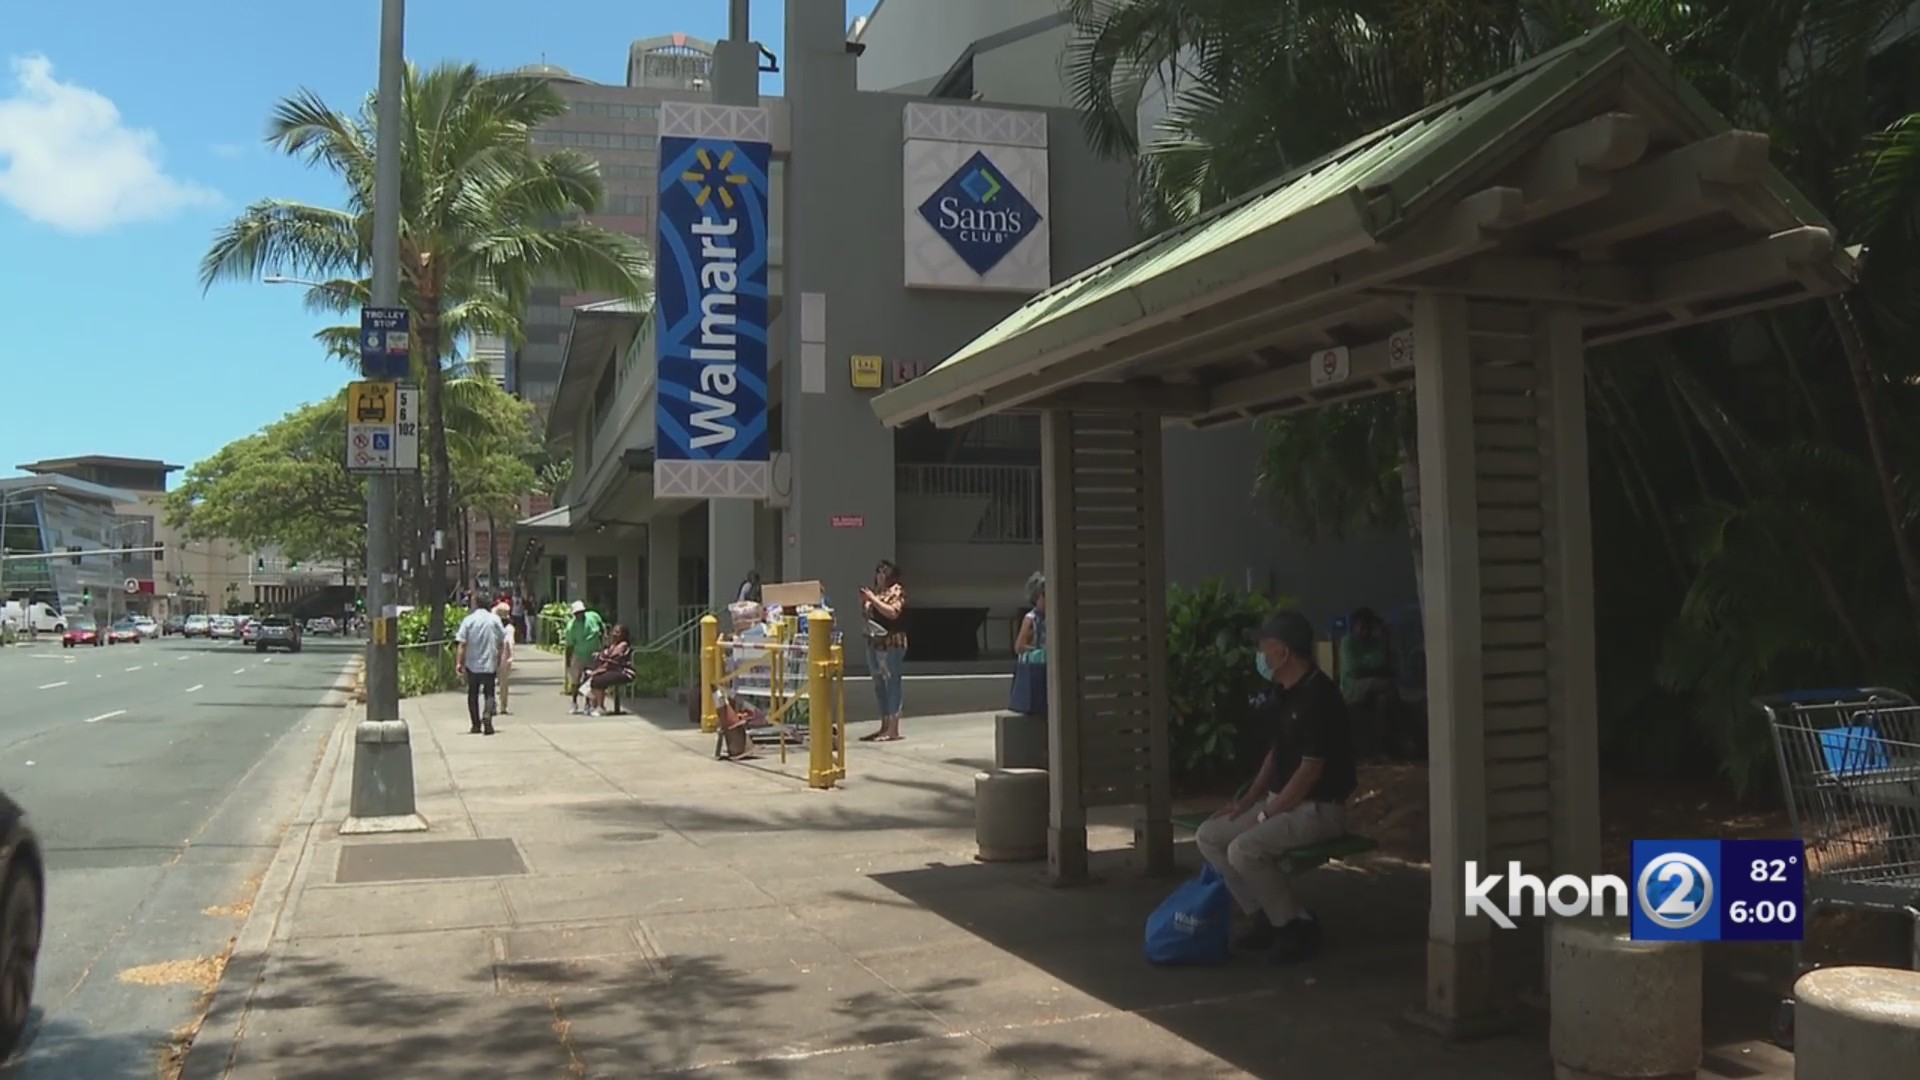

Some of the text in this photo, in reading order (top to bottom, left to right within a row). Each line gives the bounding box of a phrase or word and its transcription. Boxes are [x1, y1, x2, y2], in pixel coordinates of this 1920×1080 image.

[939, 196, 1021, 233] Sam's
[960, 230, 1003, 243] CLUB
[364, 311, 406, 320] TROLLEY
[373, 320, 397, 328] STOP
[690, 216, 738, 450] Walmart
[400, 392, 408, 406] 5
[400, 407, 407, 421] 6
[398, 422, 416, 436] 102
